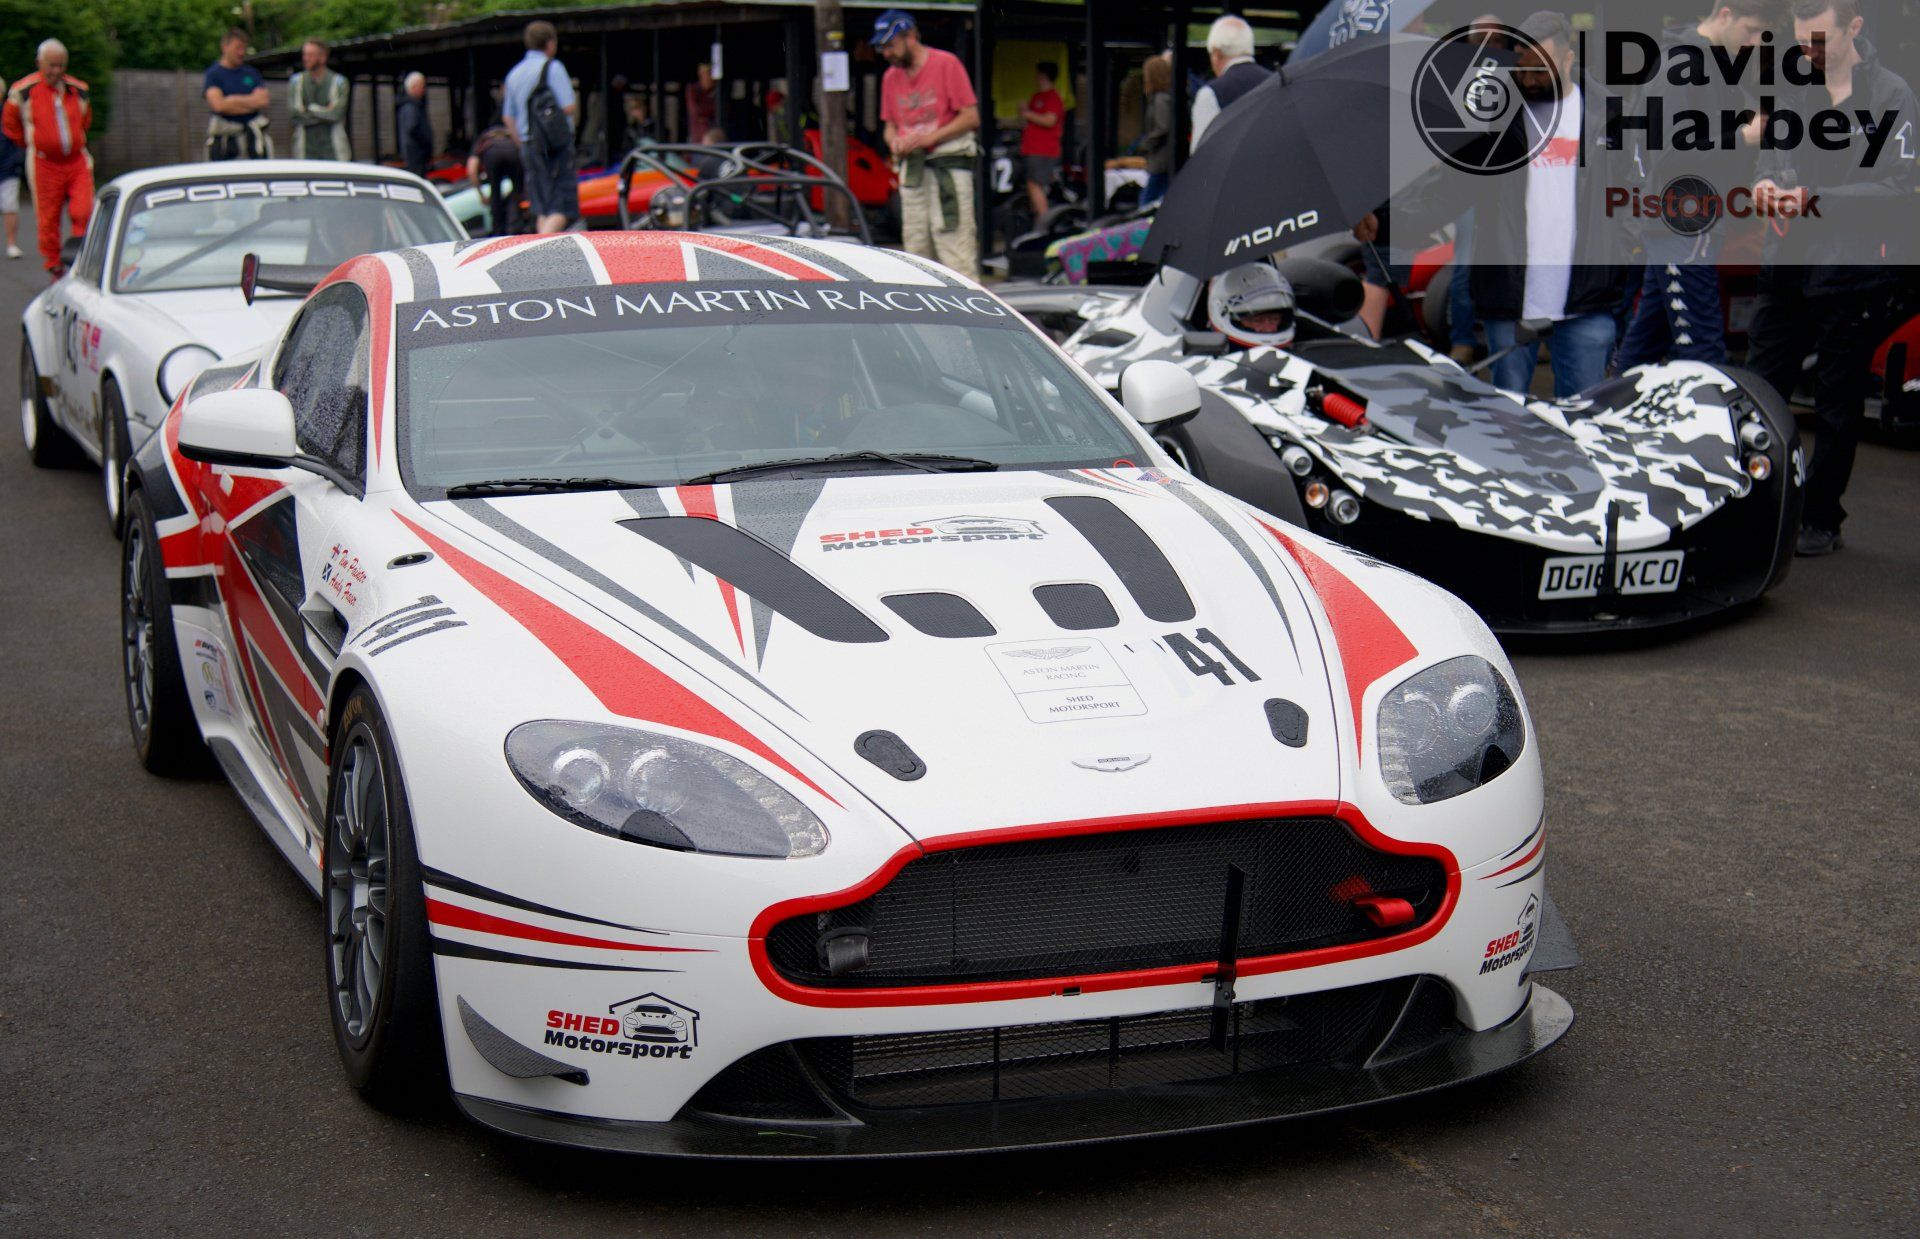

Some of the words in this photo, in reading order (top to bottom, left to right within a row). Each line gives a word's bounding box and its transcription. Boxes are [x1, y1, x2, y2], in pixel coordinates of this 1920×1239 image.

[145, 180, 425, 208] PORSCHE
[412, 296, 597, 332] ASTON
[615, 289, 810, 316] MARTIN
[816, 289, 1006, 316] RACING
[820, 526, 934, 544] SHED
[822, 532, 1044, 553] Motorsport
[1621, 558, 1679, 588] KCO
[1023, 666, 1058, 675] ASTON
[1061, 663, 1100, 672] MARTIN
[1046, 672, 1087, 681] RACING
[1049, 702, 1120, 713] MOTORSPORT
[1066, 695, 1094, 703] SHED
[1479, 934, 1535, 976] Motorsport
[1484, 929, 1520, 959] SHED
[546, 1009, 620, 1036] SHED
[544, 1029, 693, 1060] Motorsport
